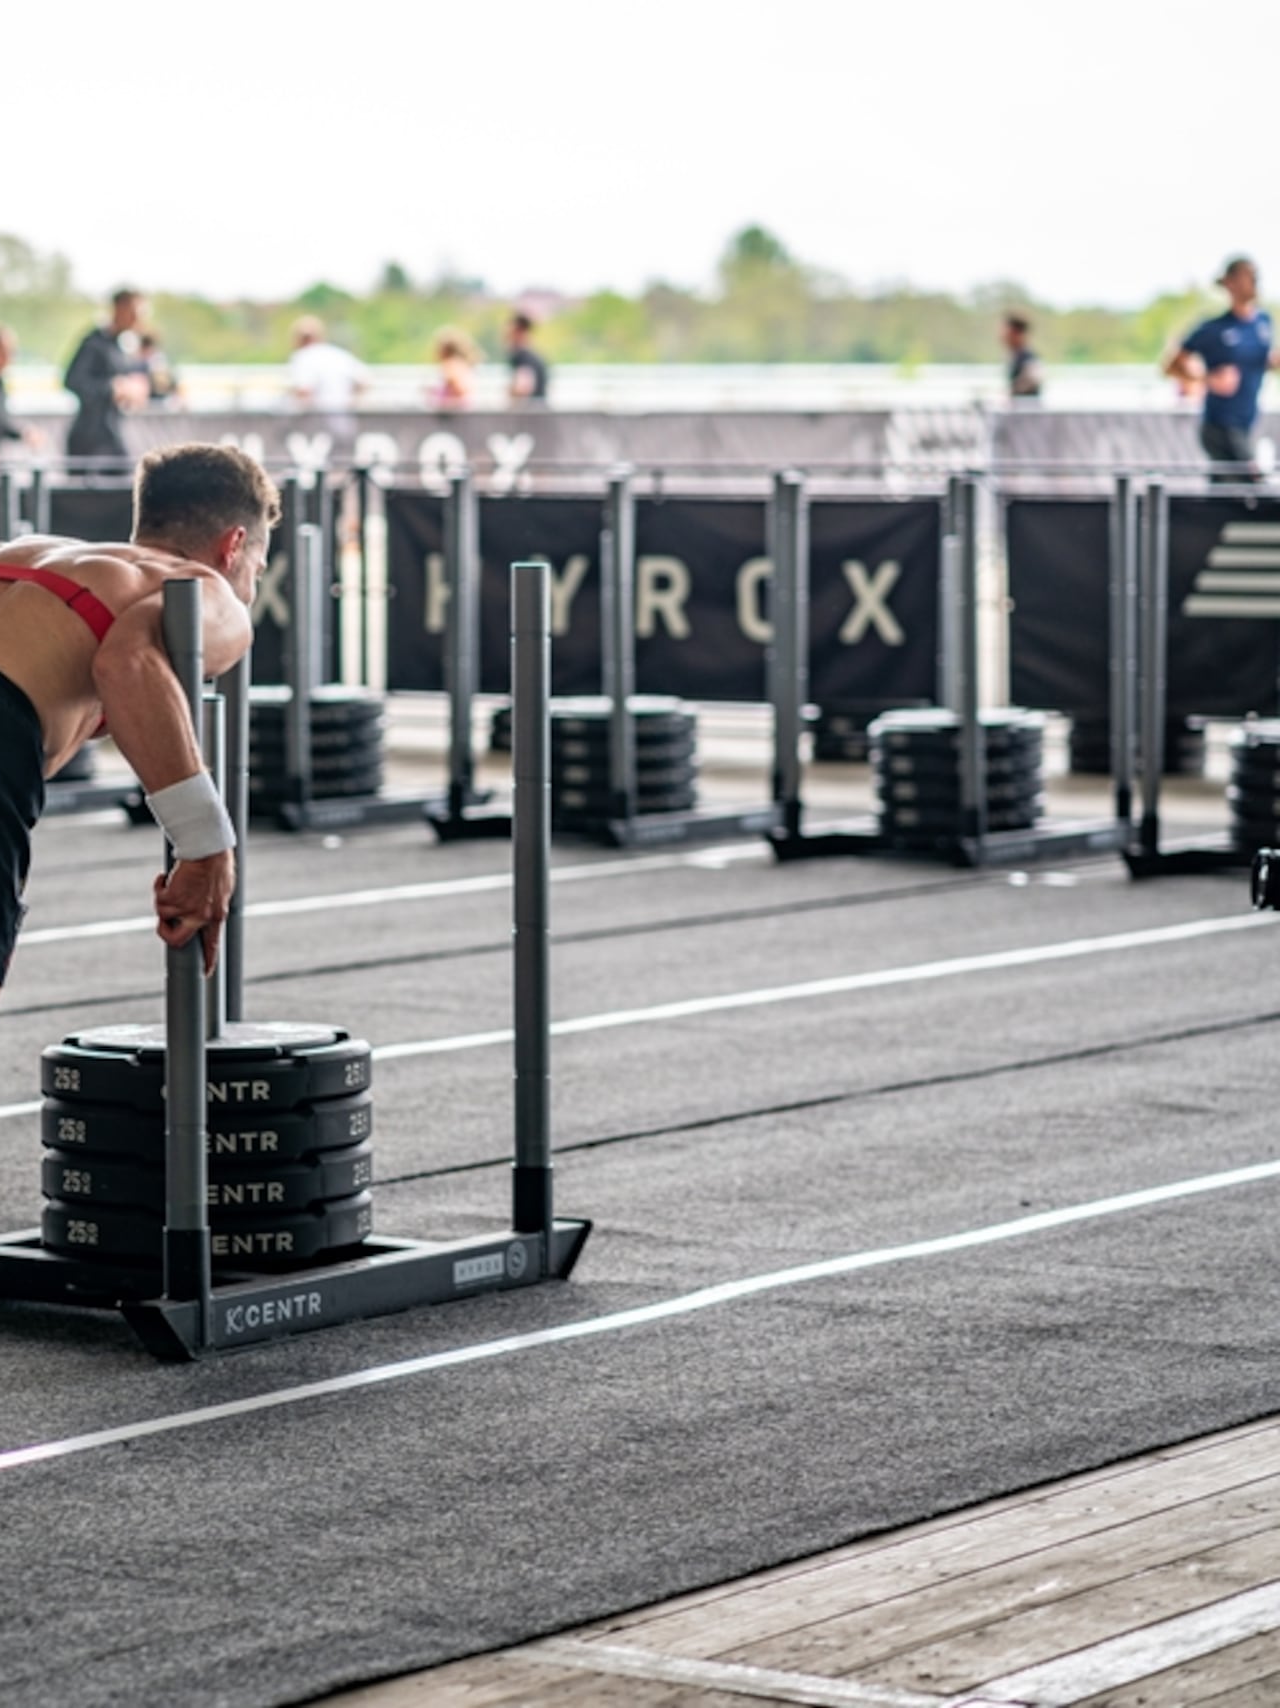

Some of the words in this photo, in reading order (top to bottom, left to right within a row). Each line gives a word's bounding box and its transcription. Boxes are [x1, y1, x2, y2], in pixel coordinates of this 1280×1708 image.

[206, 1131, 278, 1153] NTR
[207, 1182, 284, 1204] ENTR
[211, 1231, 294, 1255] ENTR
